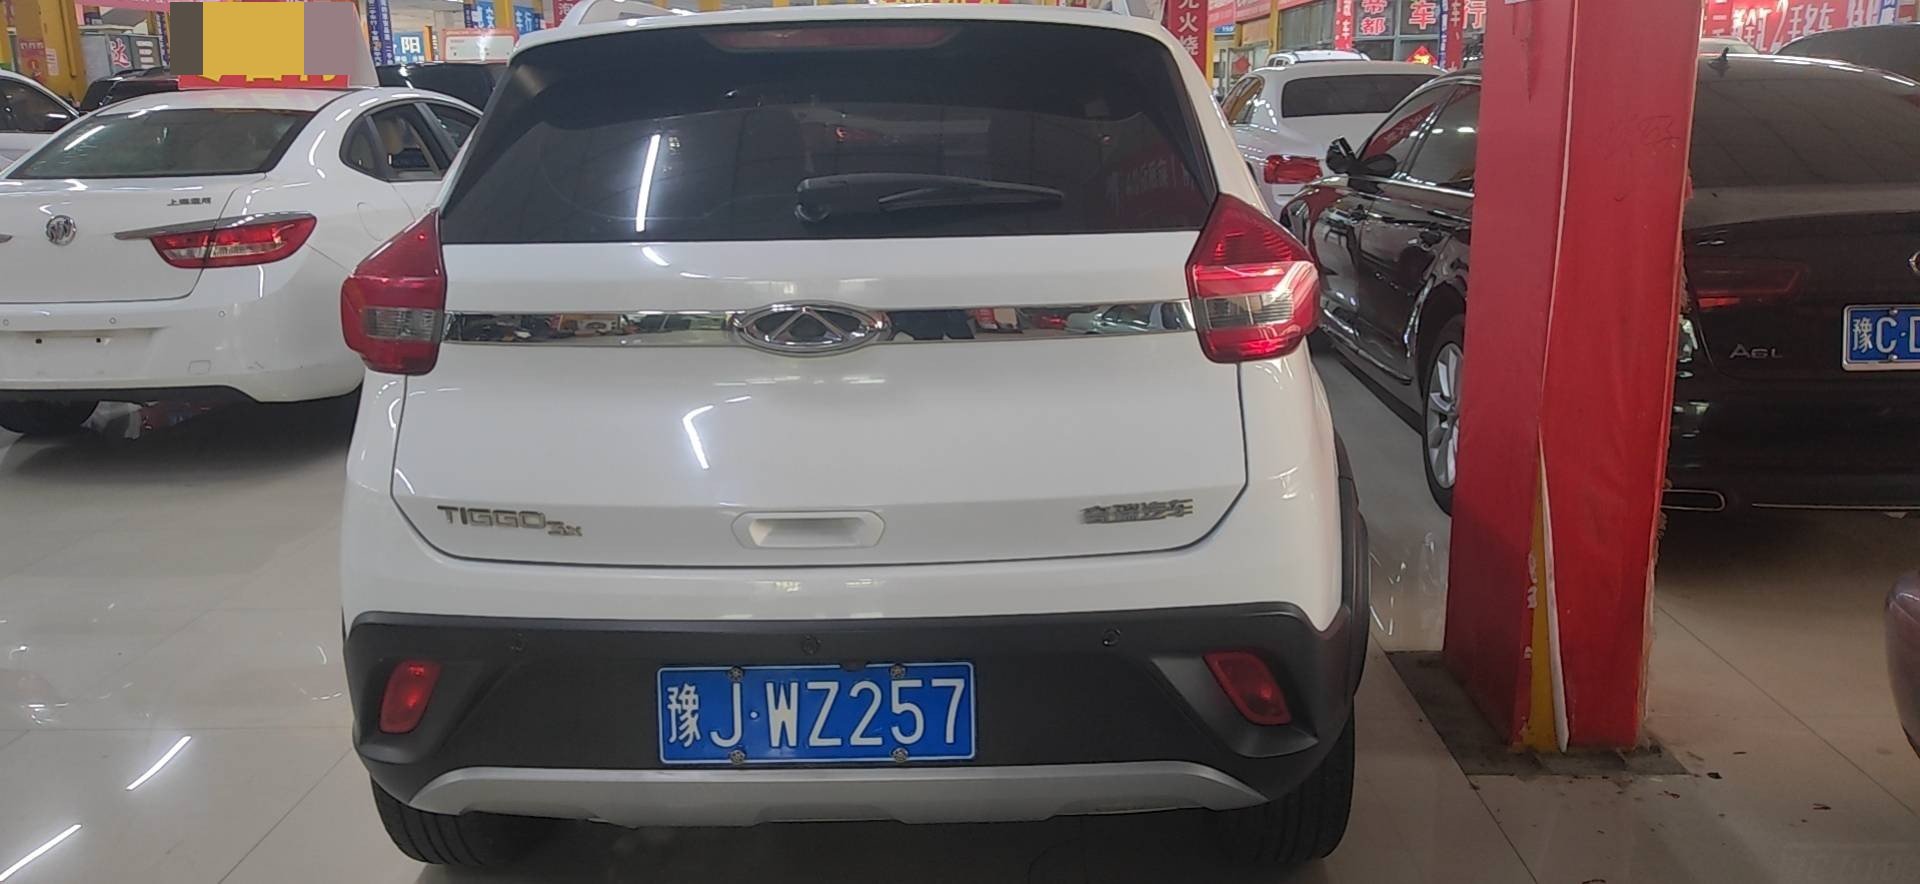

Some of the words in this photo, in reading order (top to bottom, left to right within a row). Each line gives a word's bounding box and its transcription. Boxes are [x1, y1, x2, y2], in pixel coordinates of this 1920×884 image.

[1408, 0, 1436, 30] 车
[437, 505, 546, 530] TIGGO
[667, 678, 966, 748] 豫J·WZ257
